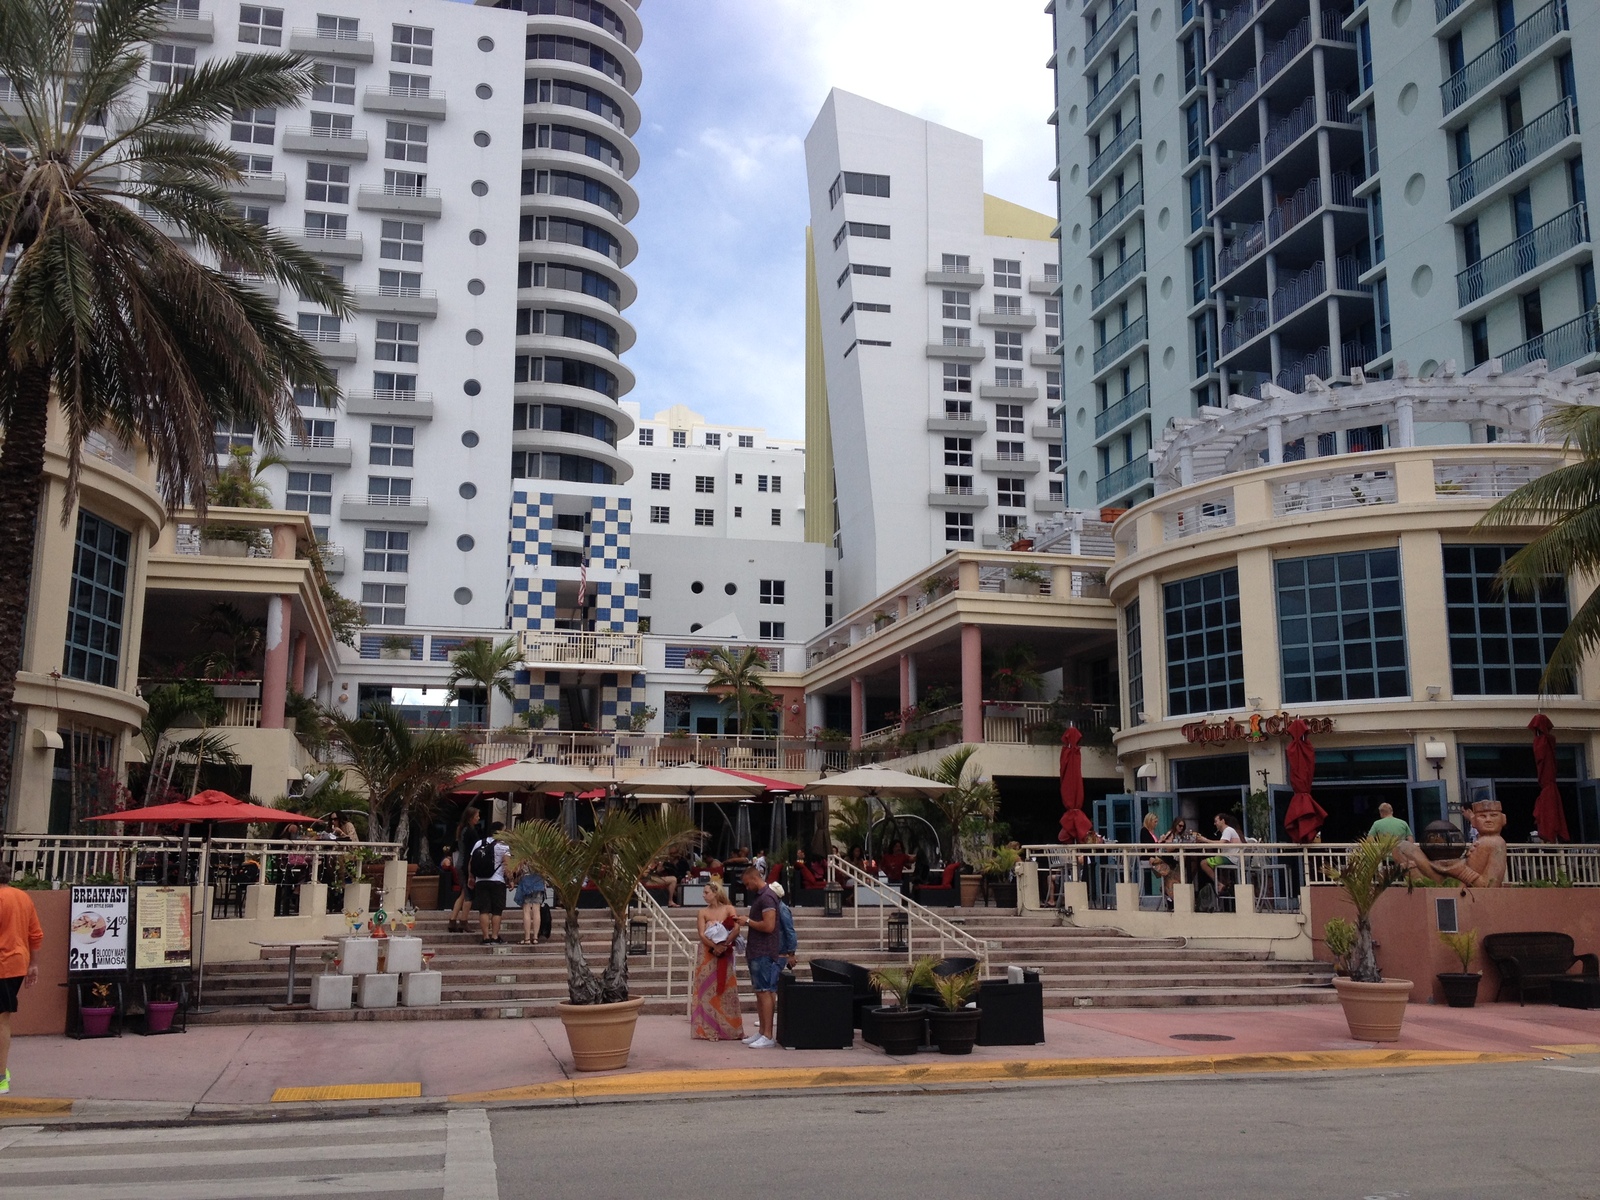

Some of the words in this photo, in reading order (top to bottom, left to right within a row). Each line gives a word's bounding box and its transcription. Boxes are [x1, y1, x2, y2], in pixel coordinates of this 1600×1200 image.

[1265, 711, 1334, 736] Chas
[73, 888, 127, 903] BREAKFAST
[70, 947, 79, 969] 2
[91, 947, 98, 969] 1
[97, 948, 114, 957] BLOODY
[114, 948, 127, 957] MARY
[97, 957, 127, 966] MIMOSA
